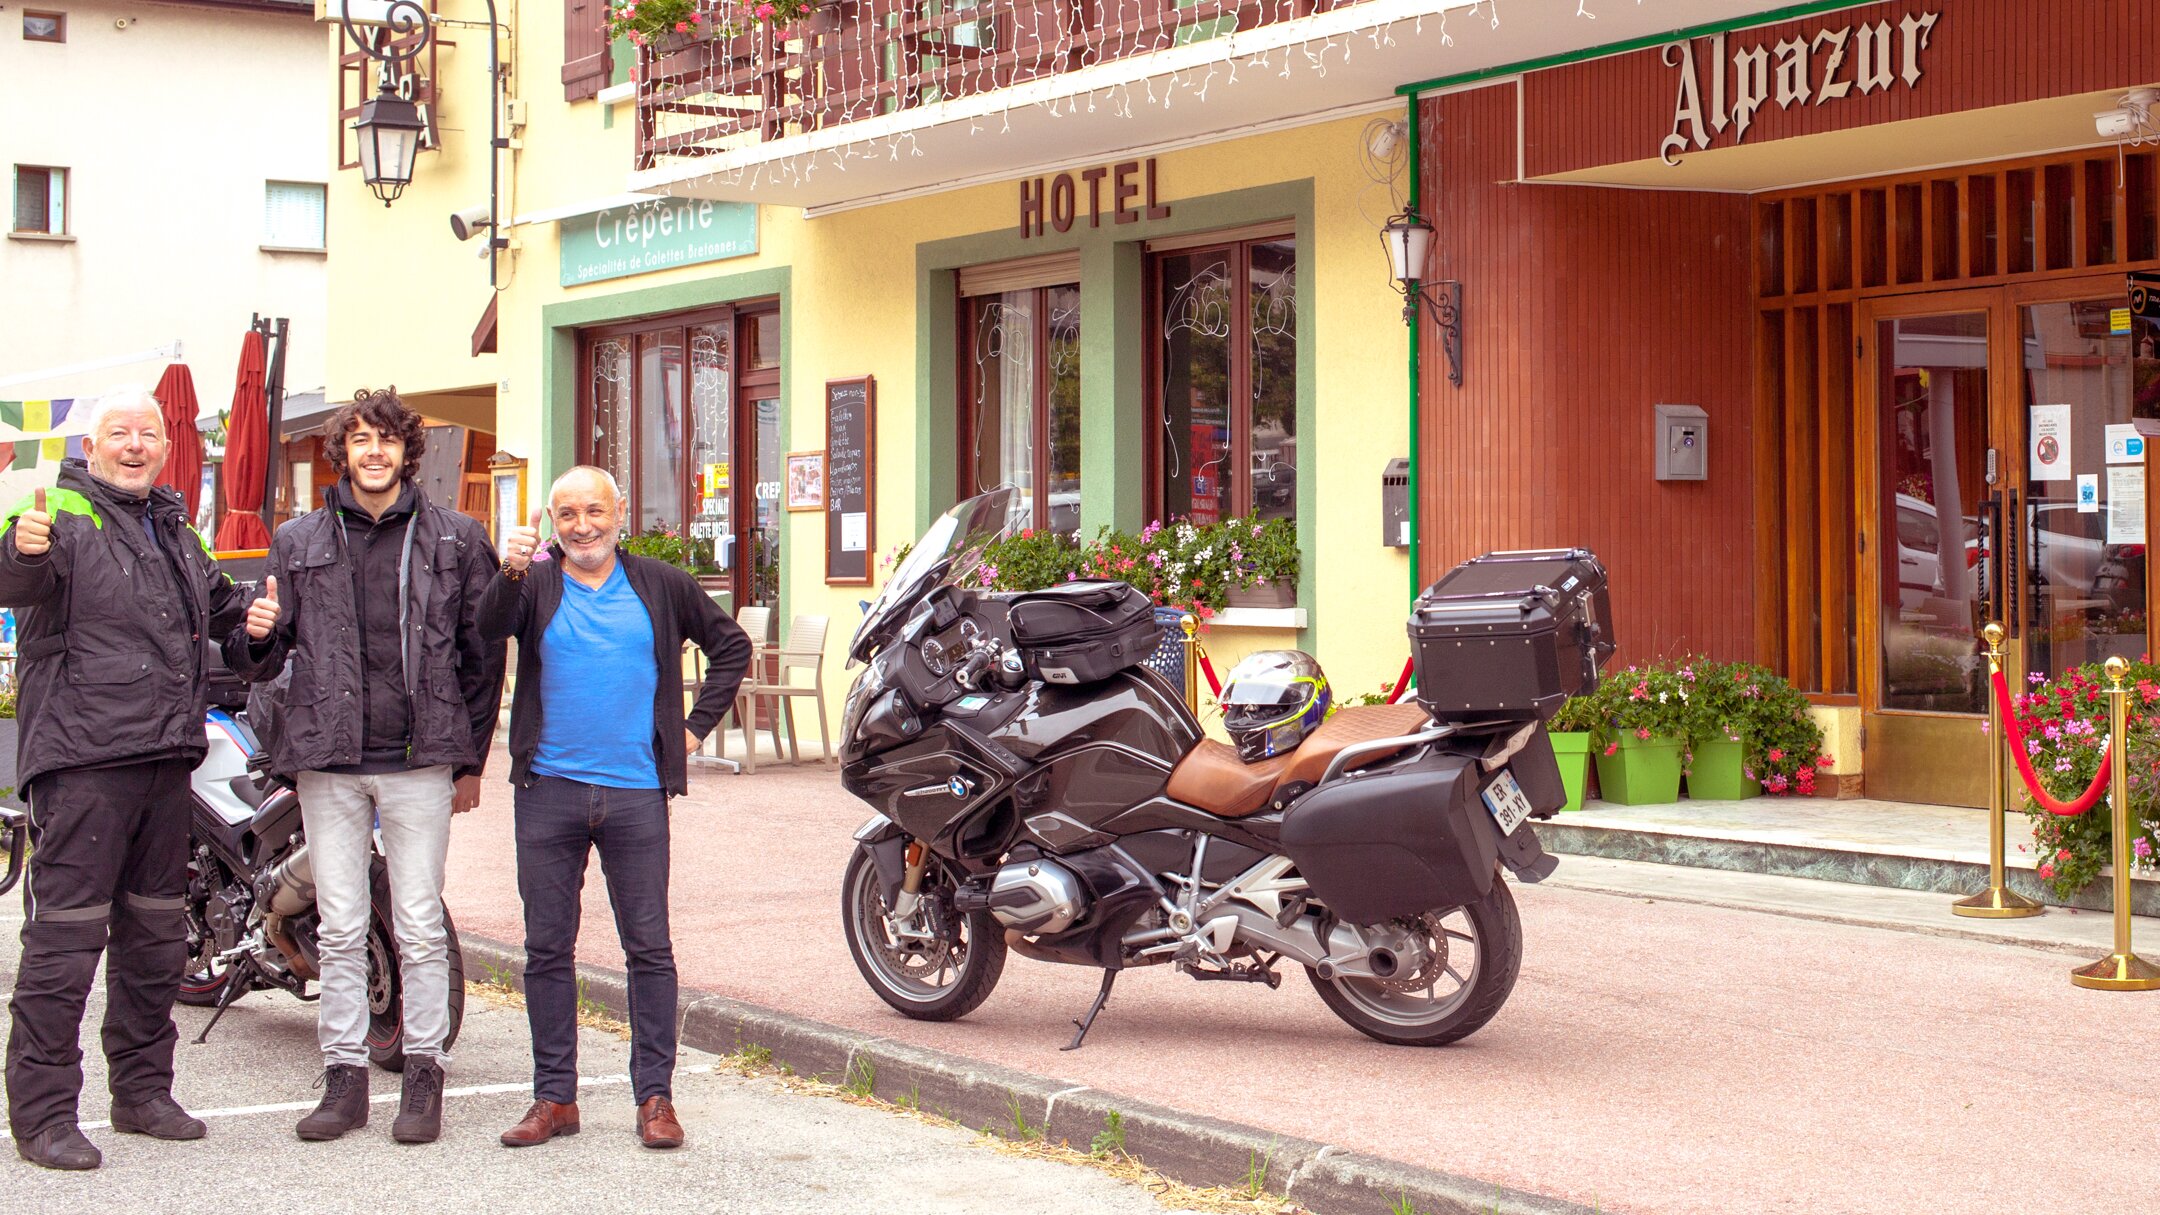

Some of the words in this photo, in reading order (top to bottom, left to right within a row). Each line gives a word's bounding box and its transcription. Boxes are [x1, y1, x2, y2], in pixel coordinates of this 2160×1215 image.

[1660, 11, 1942, 167] Alpazur
[1020, 158, 1171, 239] HOTEL
[595, 199, 714, 249] Crêperie
[577, 258, 627, 280] Spécialités
[630, 256, 642, 270] de
[644, 248, 685, 268] Galettes
[688, 239, 737, 260] Bretonnes
[830, 498, 842, 512] BAR
[2082, 491, 2094, 501] 50
